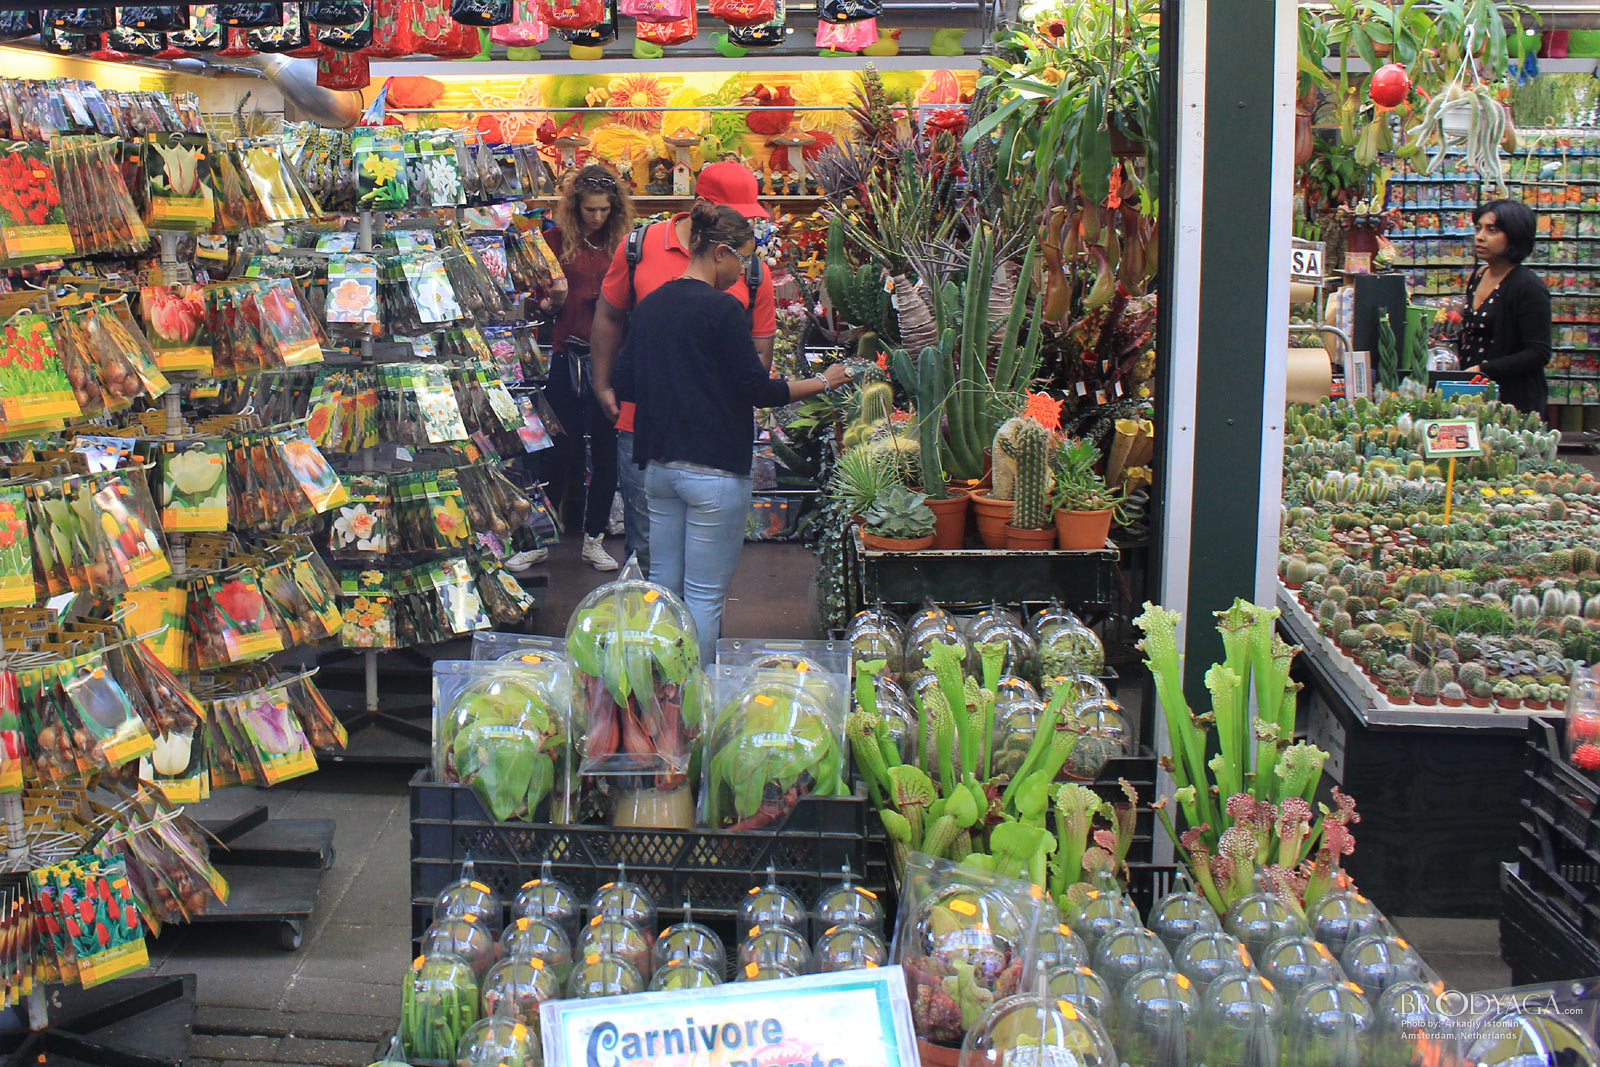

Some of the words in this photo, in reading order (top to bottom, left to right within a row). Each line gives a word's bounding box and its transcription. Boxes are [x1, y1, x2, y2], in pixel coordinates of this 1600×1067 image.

[233, 8, 259, 20] Tulipa
[320, 7, 347, 19] Tulipa
[1292, 251, 1320, 275] SA
[586, 1016, 784, 1067] Carnivore
